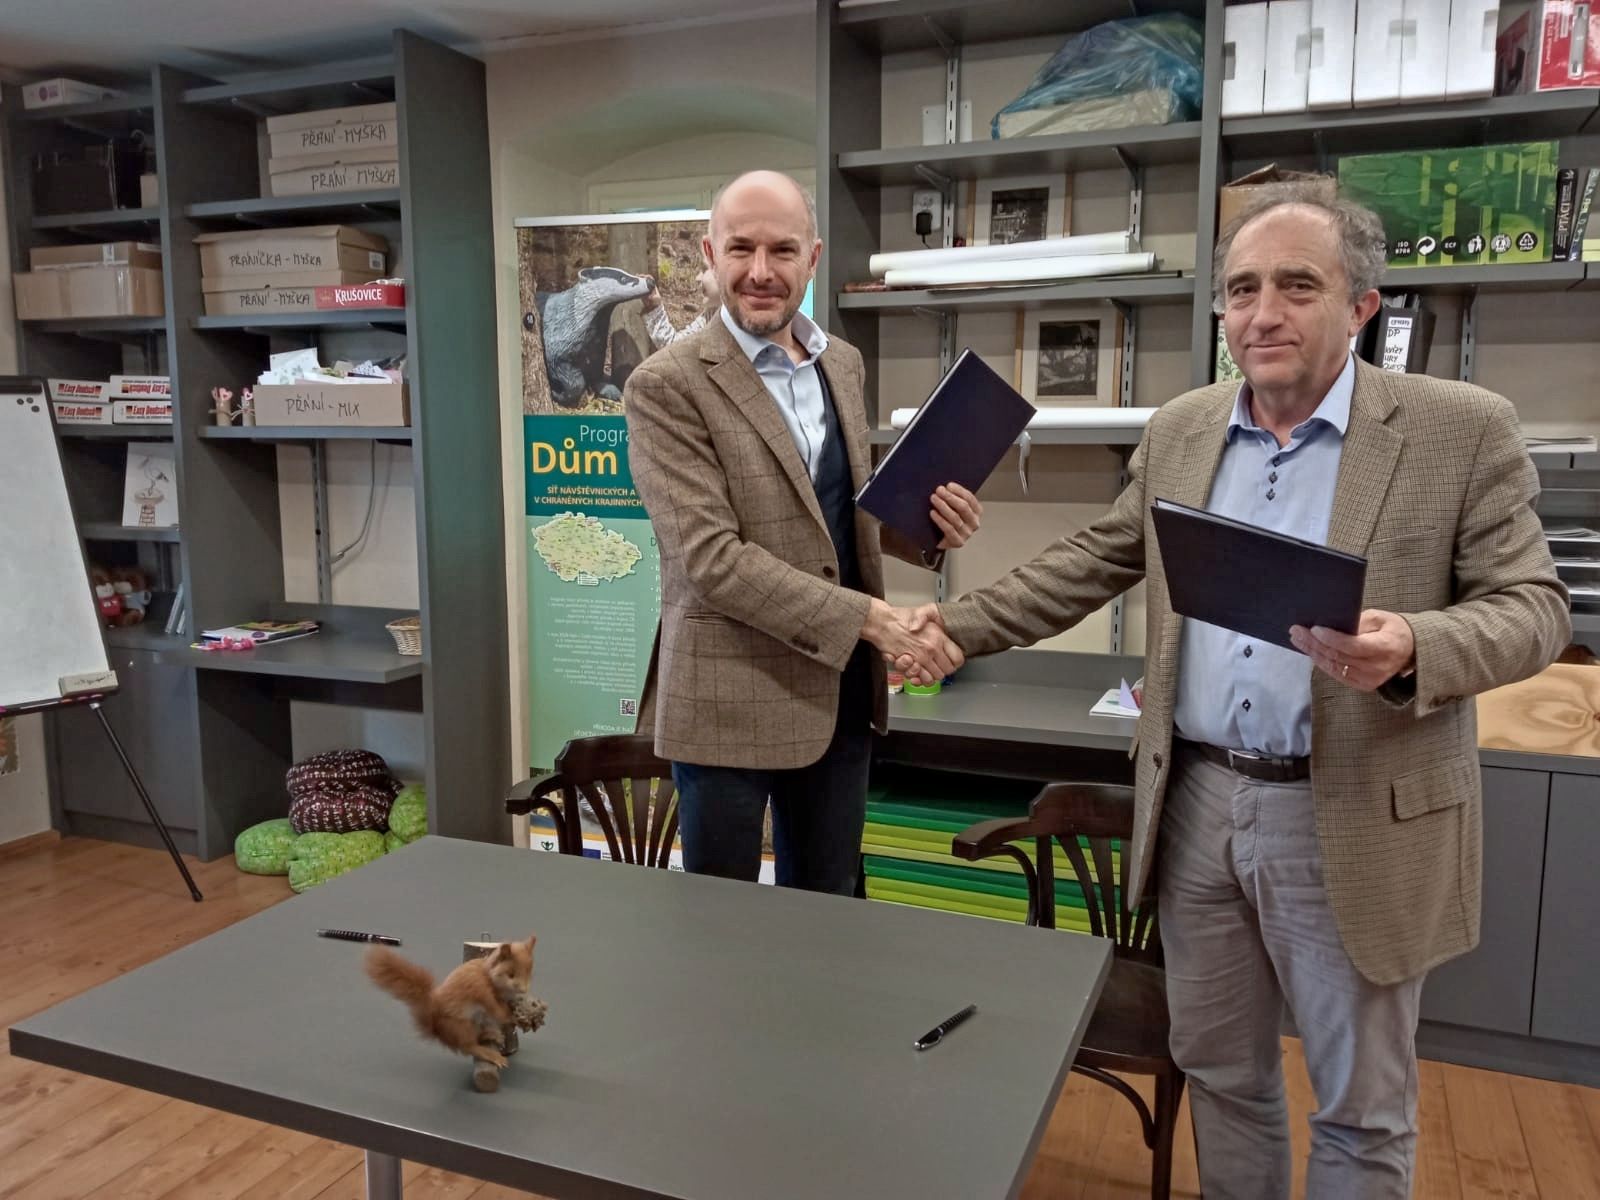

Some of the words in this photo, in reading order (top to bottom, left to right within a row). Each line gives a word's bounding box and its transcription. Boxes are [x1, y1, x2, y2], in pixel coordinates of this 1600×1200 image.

[344, 123, 386, 143] MYŠKA
[335, 288, 382, 305] KRUŠOVICE
[286, 392, 324, 415] PŘÁNÍ
[338, 403, 361, 417] MIX
[532, 437, 618, 475] Dům
[534, 496, 541, 504] V
